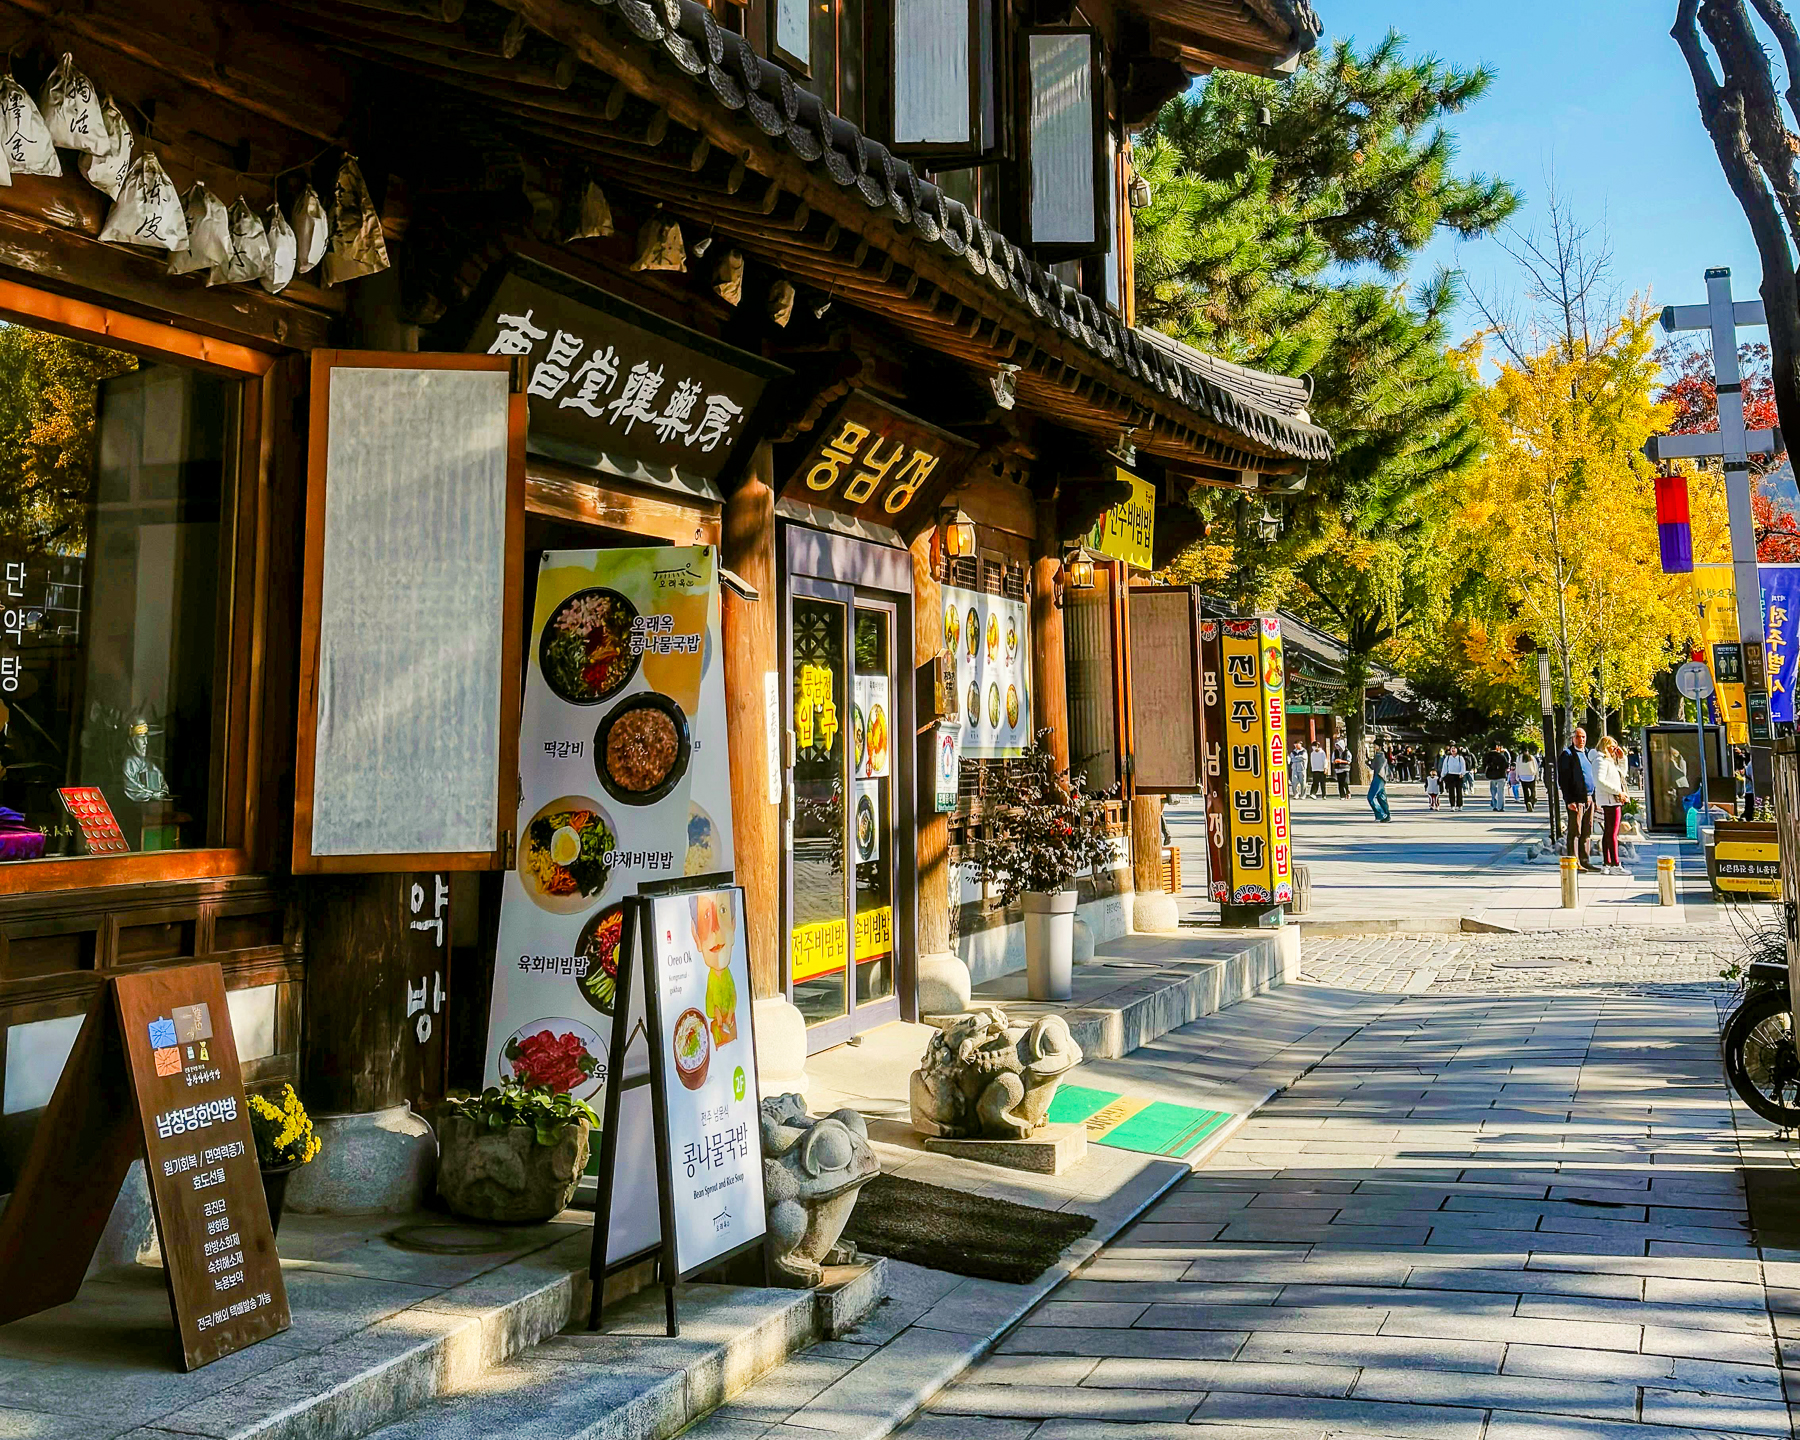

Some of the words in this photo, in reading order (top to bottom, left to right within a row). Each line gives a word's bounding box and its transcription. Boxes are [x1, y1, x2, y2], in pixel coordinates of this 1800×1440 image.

[806, 421, 940, 514] 풍남정
[631, 615, 674, 634] 오래옥
[629, 636, 701, 656] 콩나물국밥
[803, 671, 832, 700] 풍남정
[543, 741, 584, 758] 떡갈비
[1203, 671, 1224, 848] 풍남정
[1226, 654, 1266, 870] 전주비빔밥
[1269, 697, 1289, 877] 돌솥비빔밥
[602, 851, 674, 870] 야채비빔밥
[793, 922, 844, 967] 전주비빔밥
[407, 874, 449, 1043] 약방
[518, 955, 589, 976] 육회비빔밥
[156, 1096, 237, 1139] 남창당한약방
[700, 1110, 713, 1127] 전주
[163, 1156, 198, 1177] 원기회복
[205, 1140, 246, 1165] 면역력증가
[682, 1122, 748, 1178] 콩나물국밥
[192, 1167, 226, 1191] 효도선물
[693, 1186, 704, 1200] Bean
[718, 1180, 726, 1192] and
[726, 1176, 735, 1188] Rice
[735, 1173, 745, 1186] Soup
[203, 1198, 227, 1217] 공진단
[207, 1217, 230, 1236] 쌍화탕
[203, 1232, 241, 1257] 한방소화제
[207, 1251, 244, 1275] 숙취해소제
[214, 1270, 244, 1291] 녹용보약
[197, 1308, 230, 1332] 전국/해외
[229, 1296, 258, 1317] 택배발송
[257, 1291, 272, 1307] 가능
